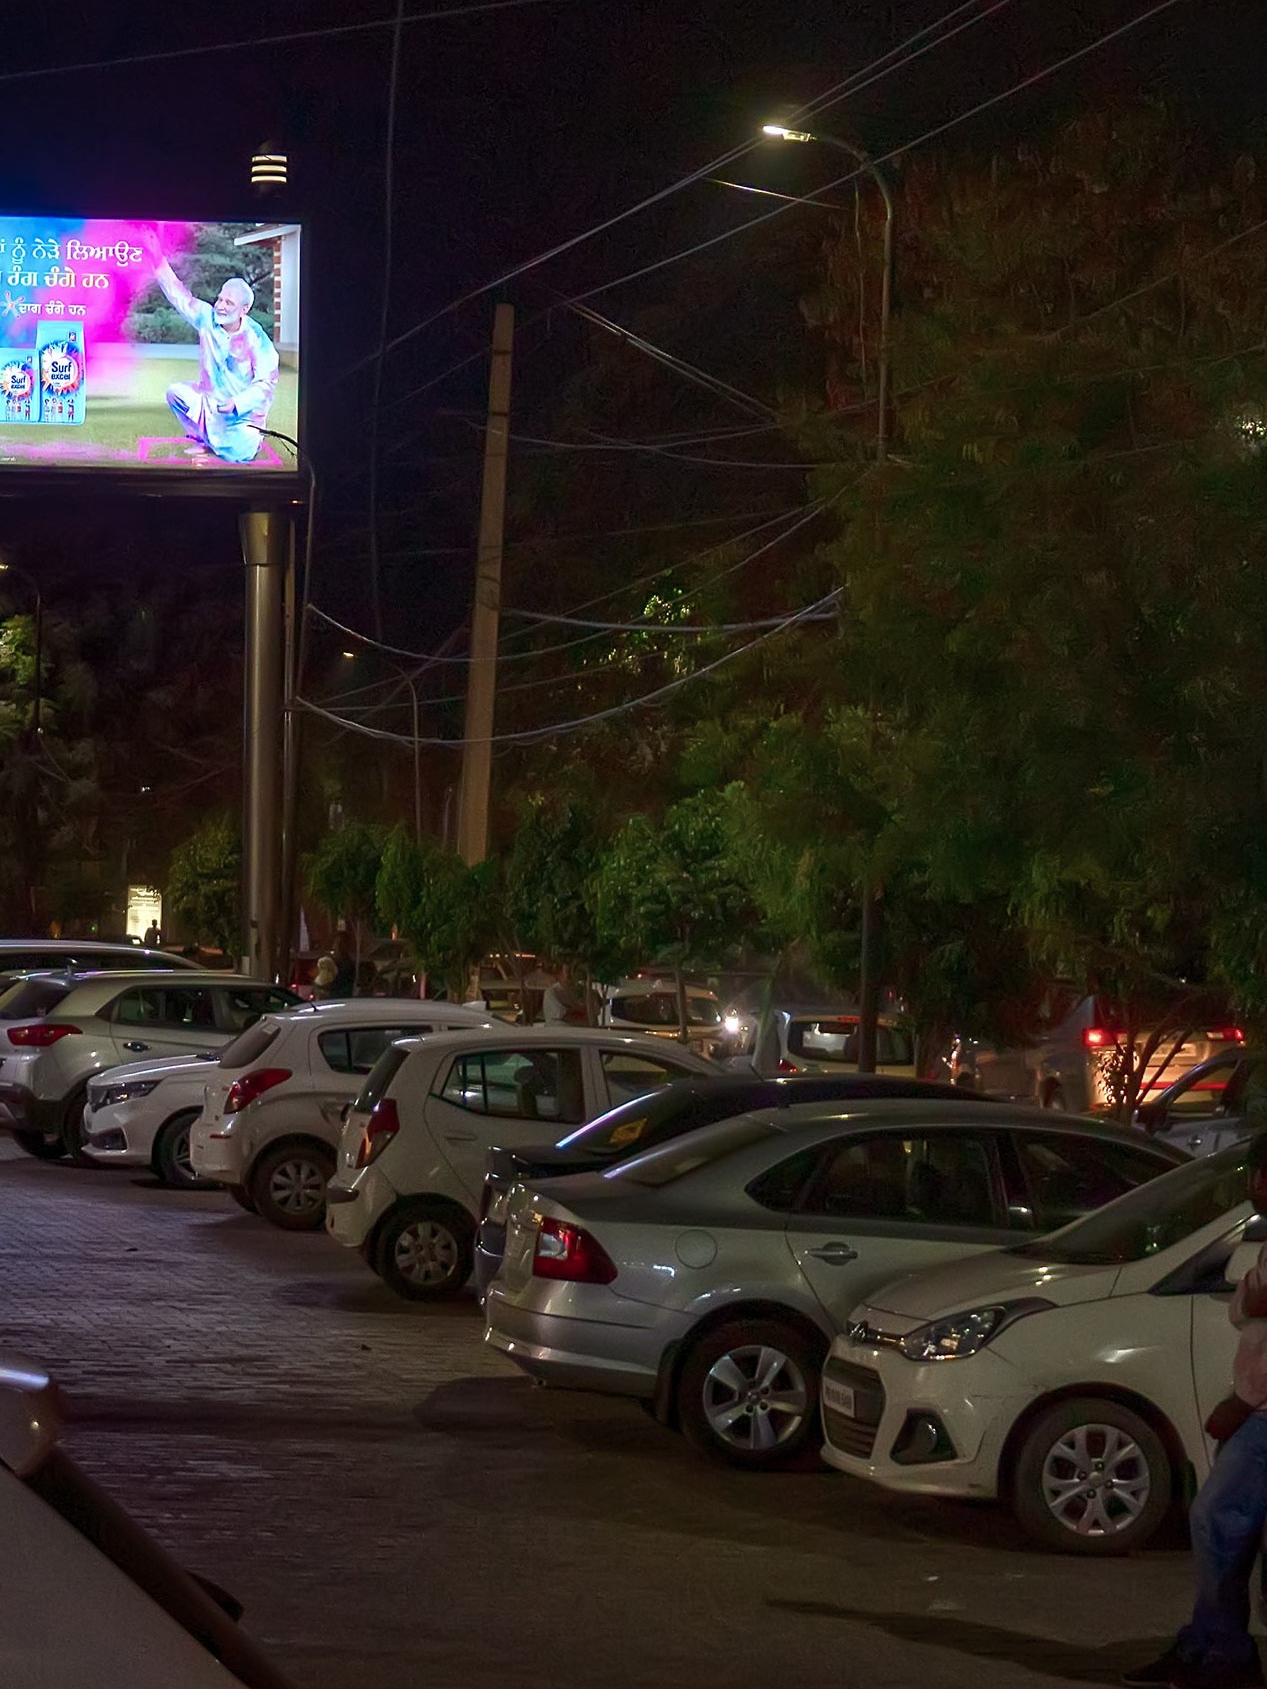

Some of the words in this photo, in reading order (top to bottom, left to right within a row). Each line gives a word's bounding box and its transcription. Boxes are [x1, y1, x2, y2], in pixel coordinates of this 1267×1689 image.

[11, 237, 26, 264] ਨੂੰ
[32, 238, 60, 259] ਨੇੜੇ
[66, 239, 144, 267] ਲਿਆਉਣ
[7, 265, 38, 287] ਰੰਗ
[44, 266, 77, 287] ਚੰਗੇ
[82, 273, 110, 288] ਹਨ
[51, 361, 72, 373] Surf
[11, 375, 26, 383] Surf
